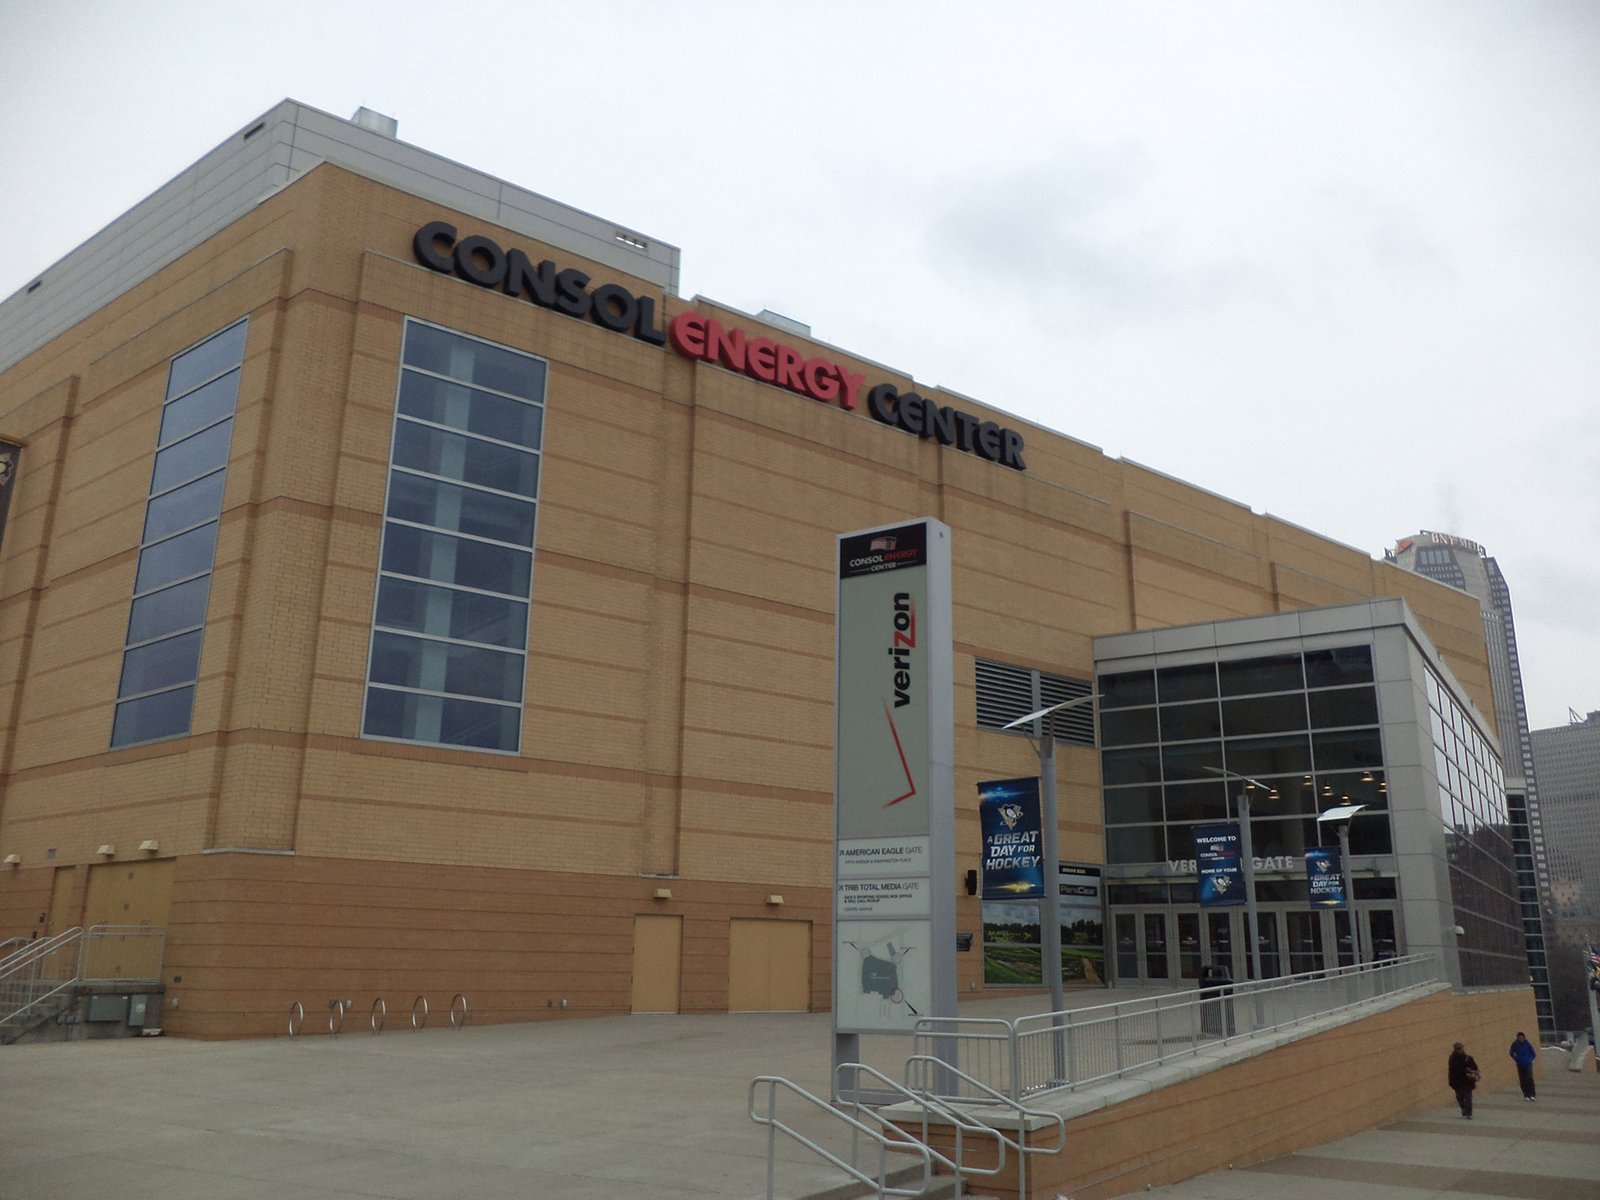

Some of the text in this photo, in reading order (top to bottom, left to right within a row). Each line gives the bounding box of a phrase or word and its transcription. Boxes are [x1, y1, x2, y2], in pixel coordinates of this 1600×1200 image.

[413, 220, 1027, 471] CONSOL ENERGY CENTER
[849, 548, 918, 567] CONSOL ENERGY
[870, 562, 897, 571] CENTER
[888, 592, 916, 708] verizon
[994, 831, 1039, 845] GREAT
[845, 846, 922, 856] AMERICAN EAGLE GATE
[990, 845, 1035, 857] DAY FOR
[986, 856, 1040, 871] HOCKEY
[1252, 856, 1293, 869] GATE
[1310, 886, 1343, 894] HOCKEY
